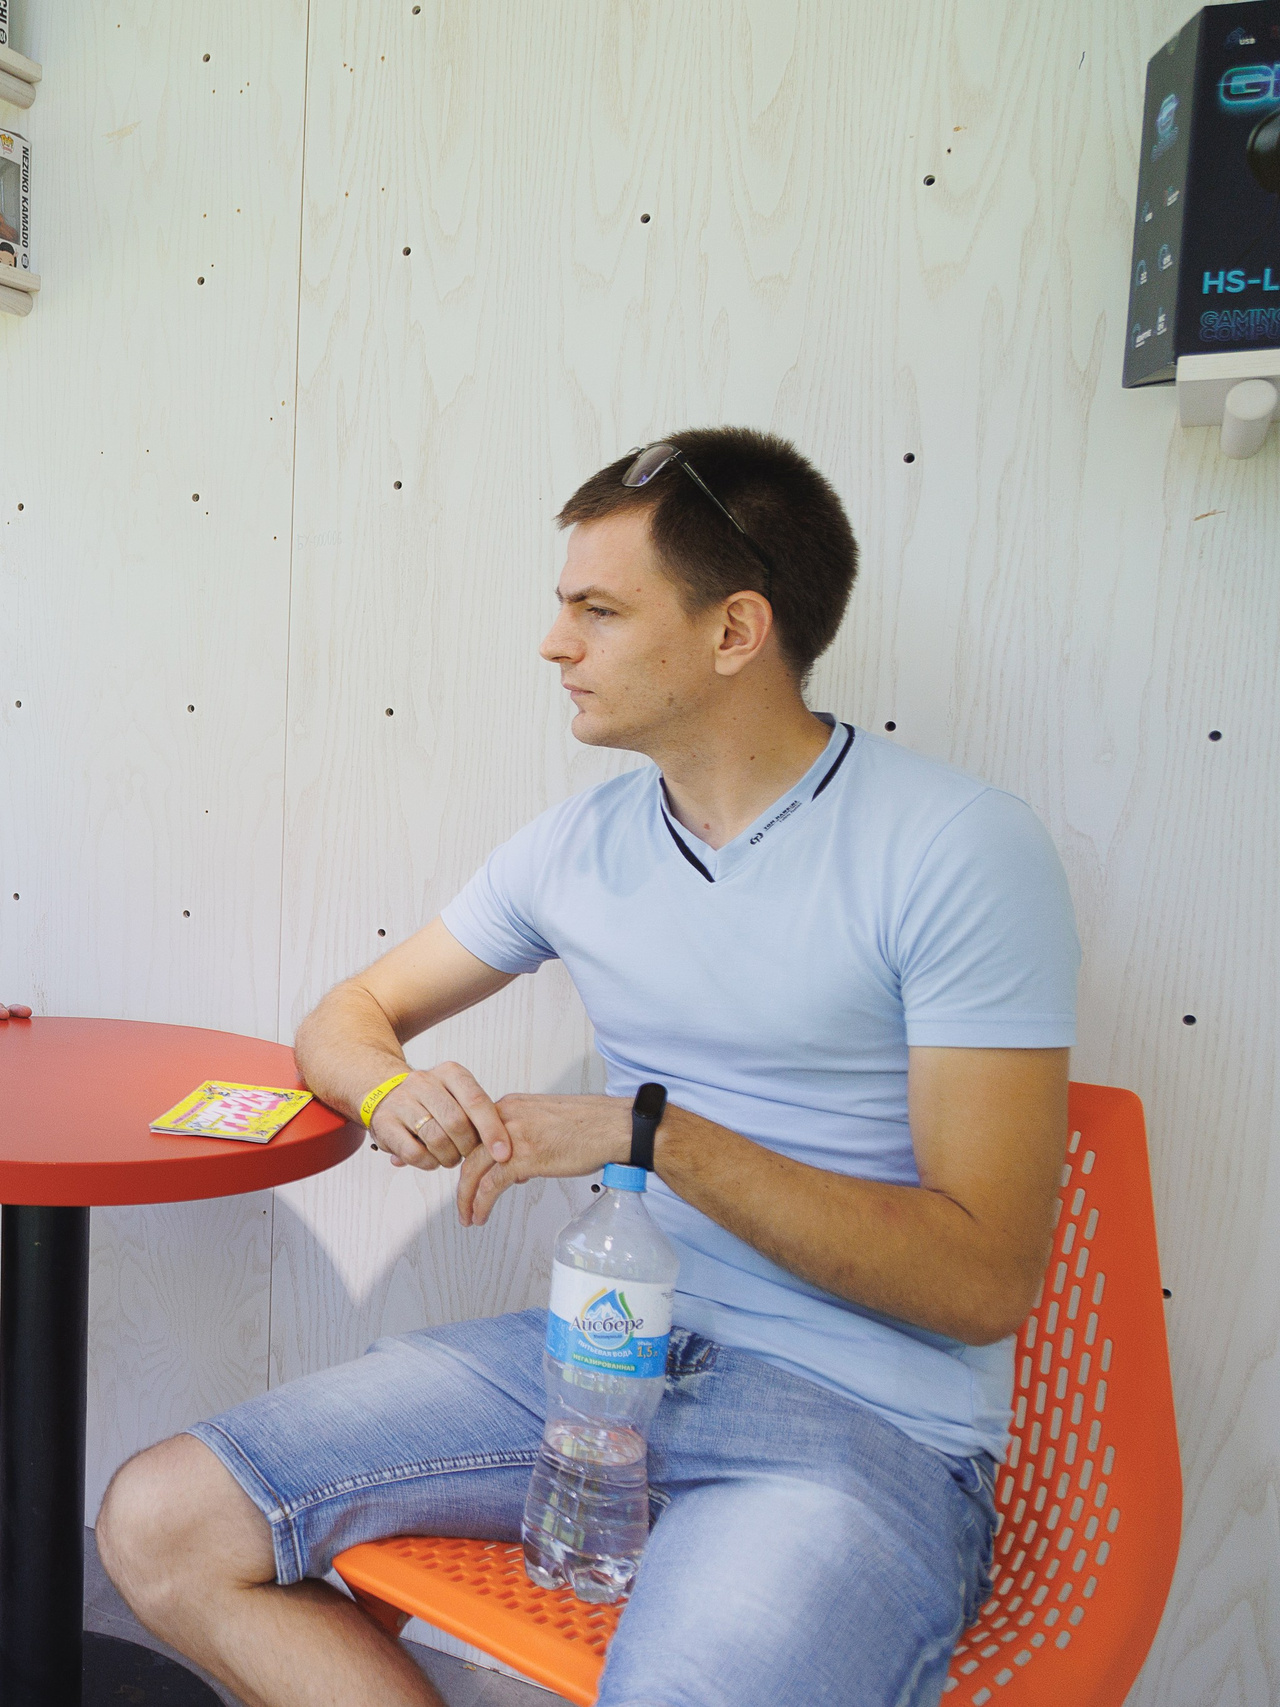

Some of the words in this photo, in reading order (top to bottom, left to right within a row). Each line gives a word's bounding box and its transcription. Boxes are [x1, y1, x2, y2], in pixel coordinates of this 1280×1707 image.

[21, 146, 30, 193] NEZUKO
[21, 196, 29, 248] KAMADO
[570, 1316, 644, 1335] Айсберг
[612, 1349, 634, 1358] ВОДА
[637, 1346, 653, 1358] 1,5
[573, 1354, 635, 1371] НЕГАЗИРОВАННАЯ
